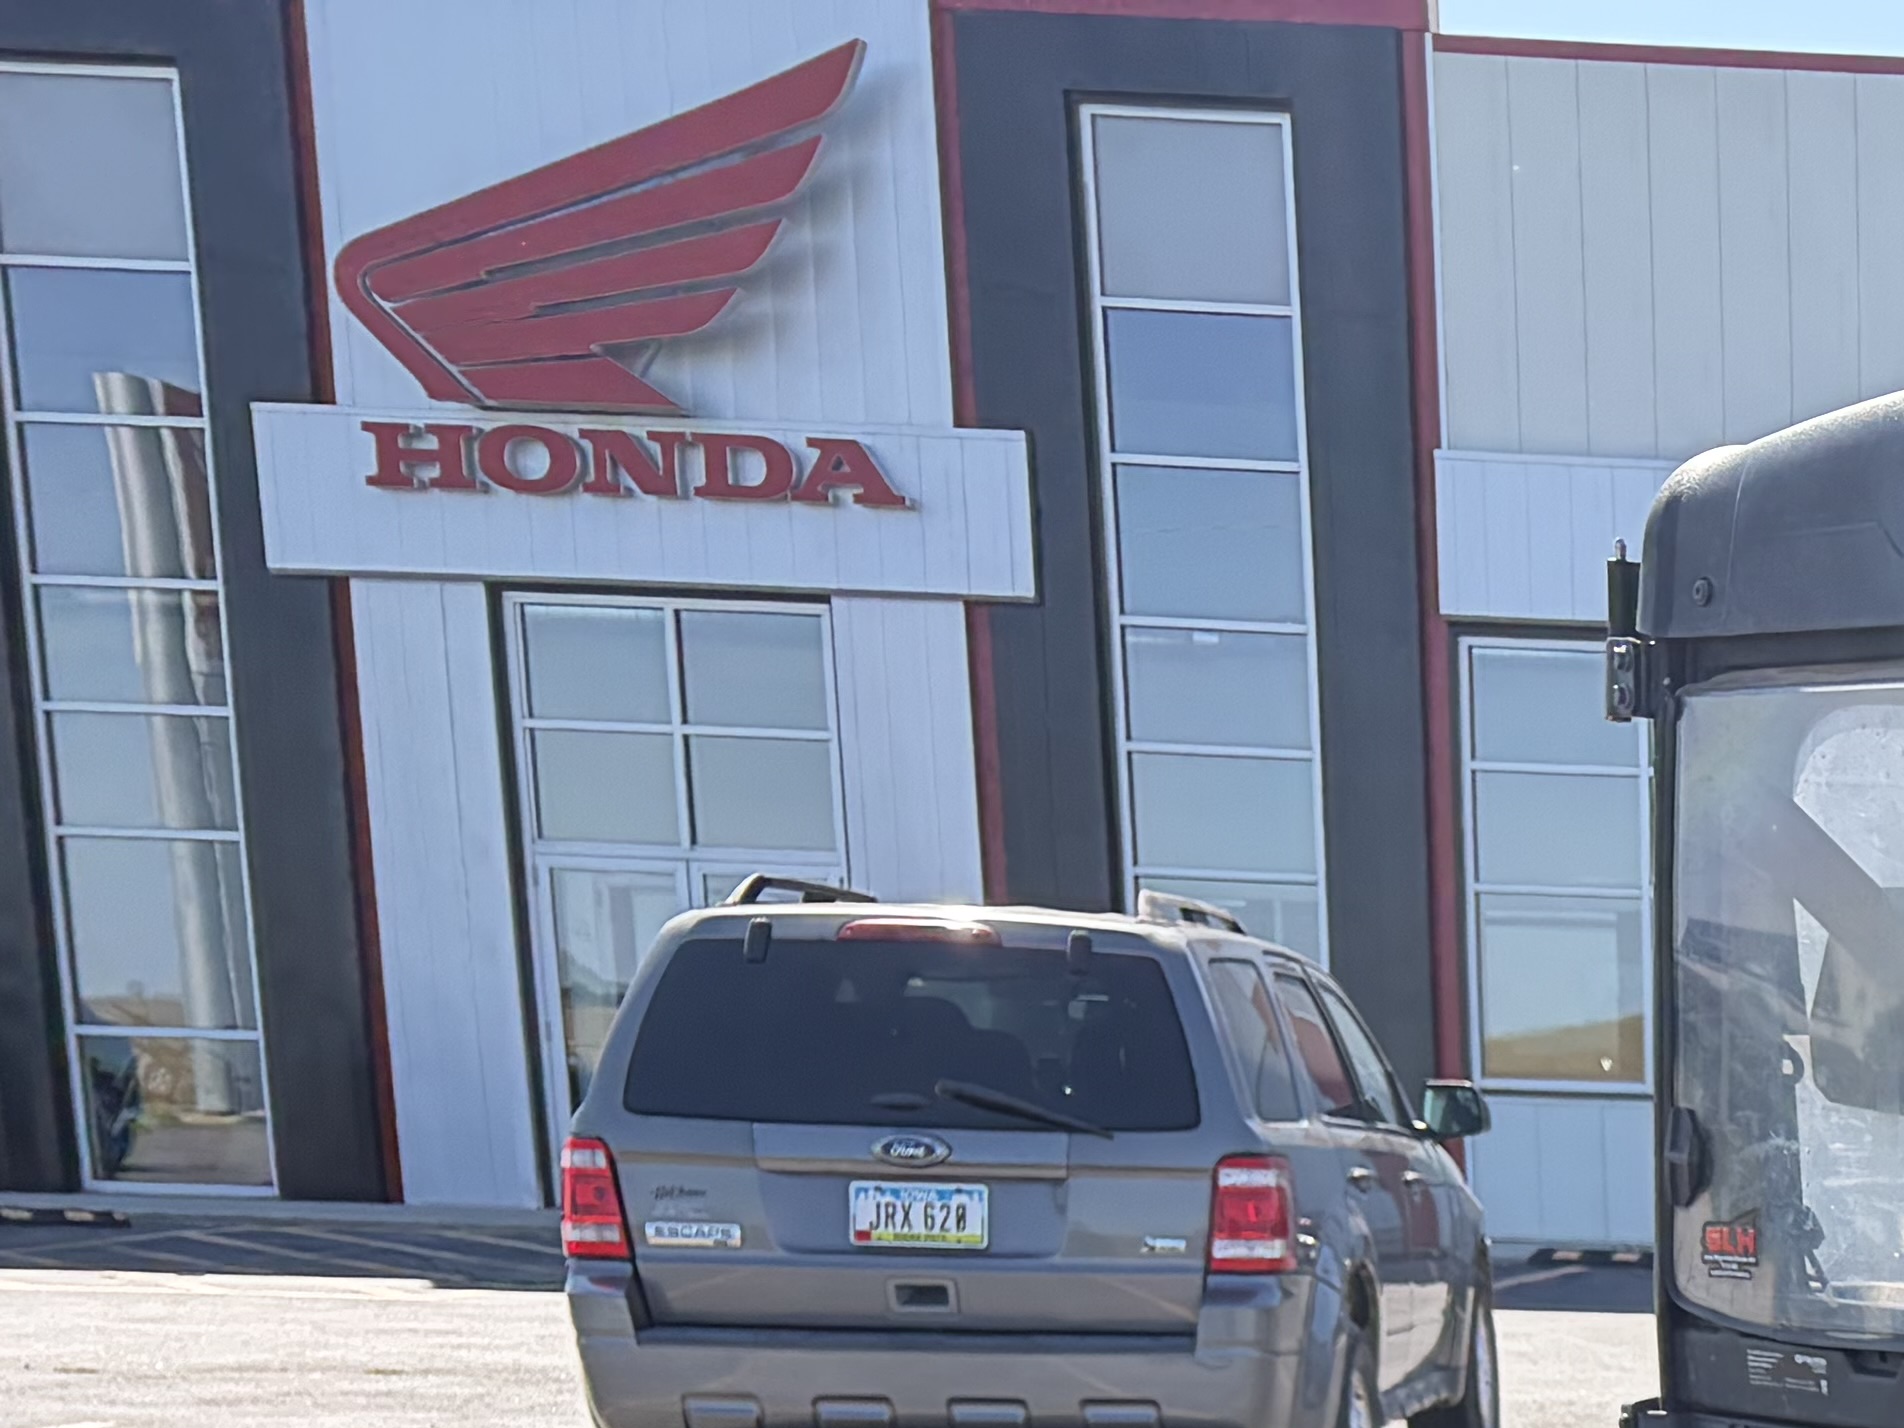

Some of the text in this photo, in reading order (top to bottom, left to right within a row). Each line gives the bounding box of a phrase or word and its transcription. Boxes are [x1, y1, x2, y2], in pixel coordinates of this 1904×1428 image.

[361, 421, 908, 509] HONDA
[890, 1140, 926, 1158] Ford
[869, 1201, 967, 1233] JRX 620
[655, 1225, 732, 1240] ESCAPE
